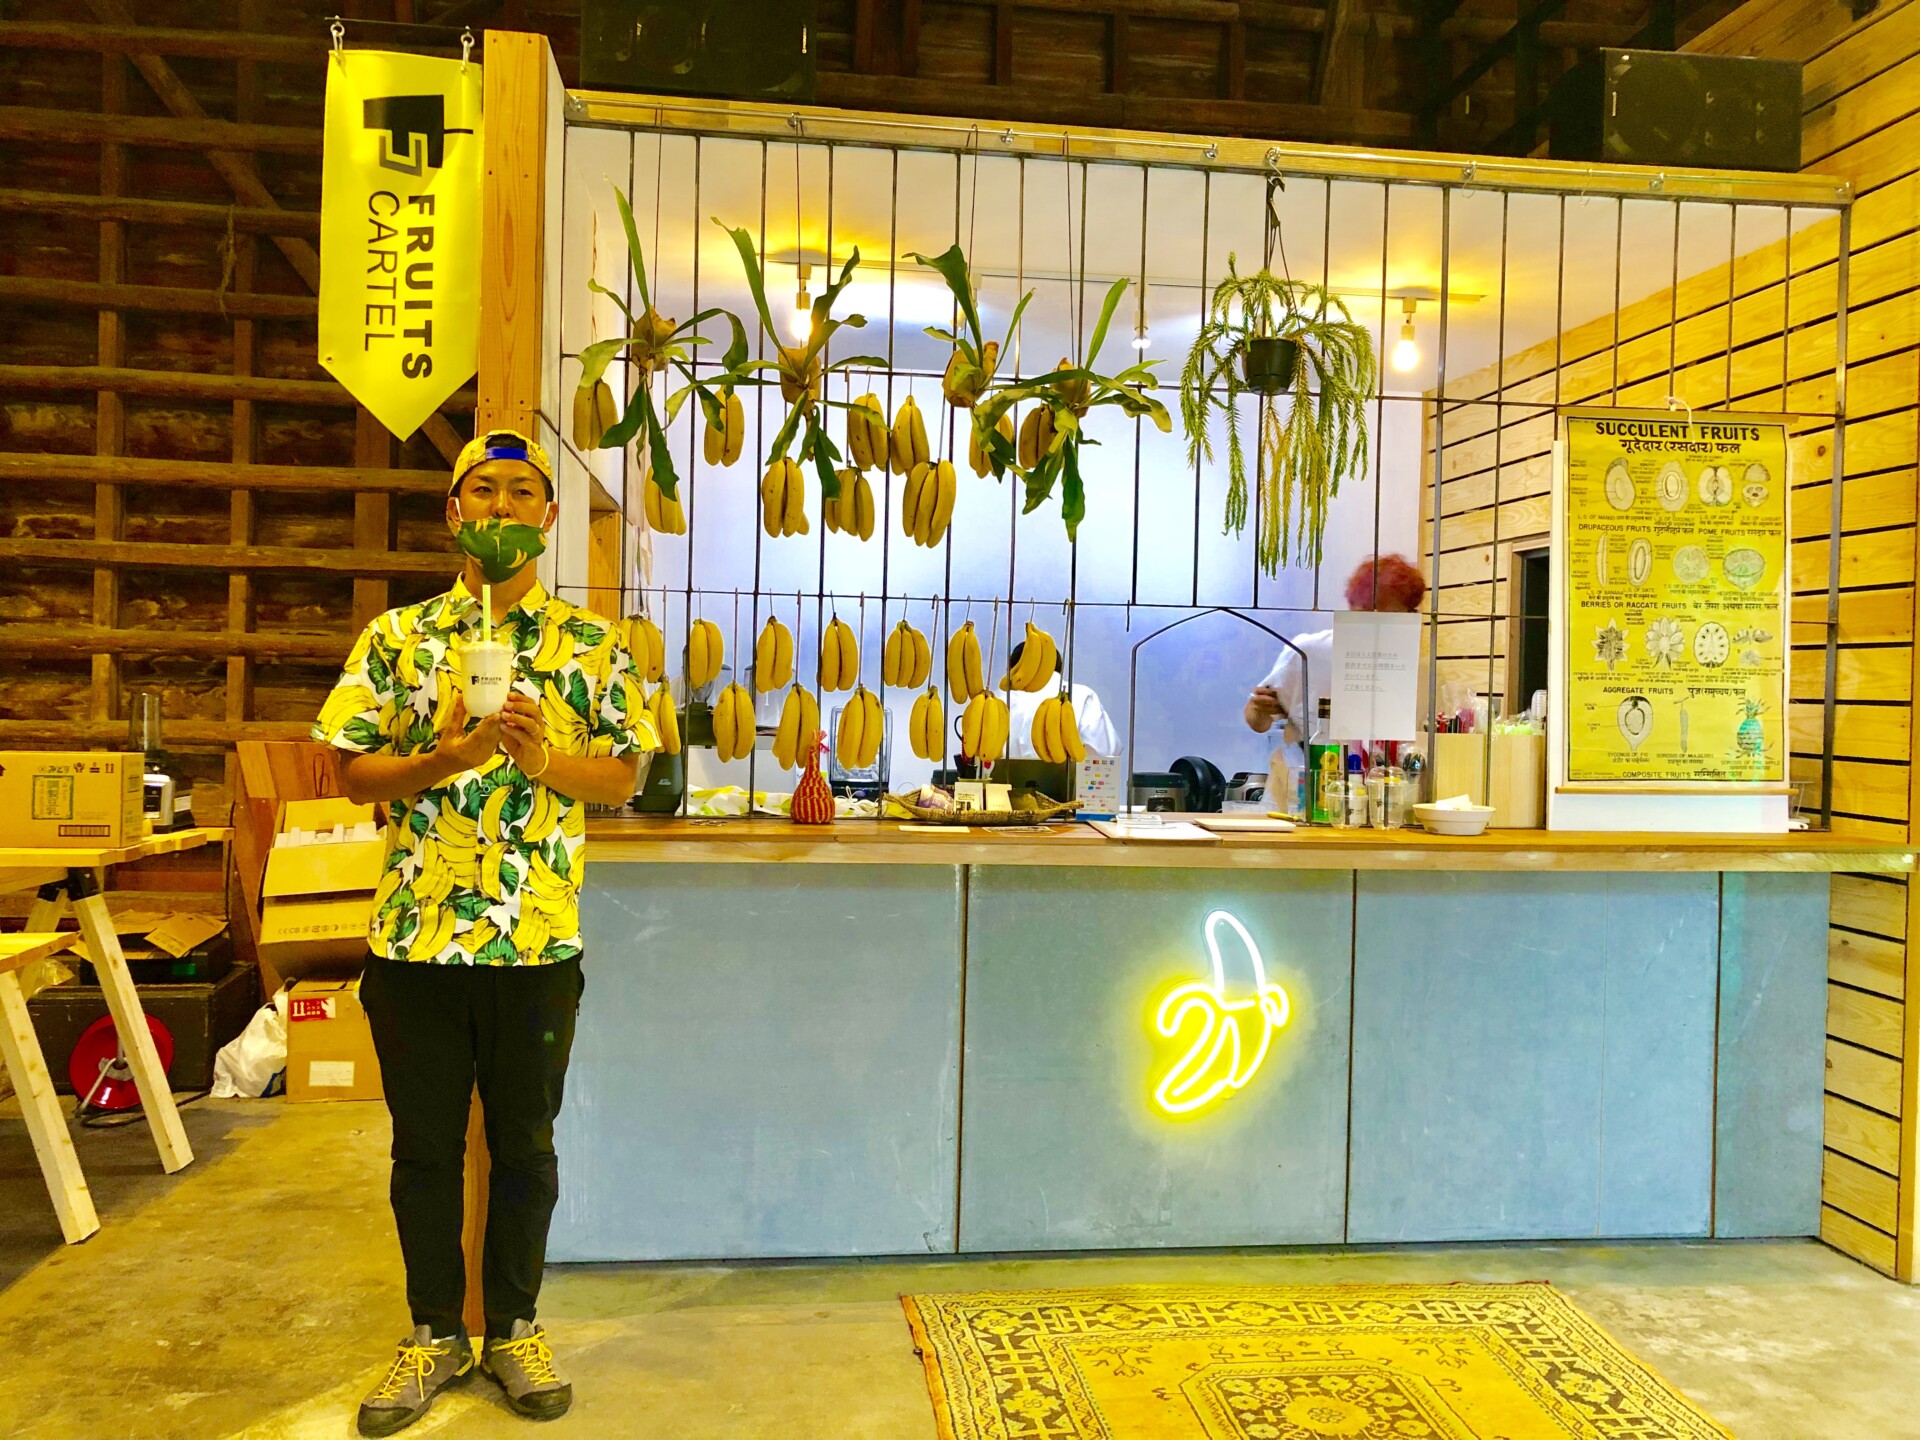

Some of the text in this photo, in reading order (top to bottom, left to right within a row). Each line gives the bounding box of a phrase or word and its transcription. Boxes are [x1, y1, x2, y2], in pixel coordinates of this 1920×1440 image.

[364, 190, 400, 352] CARTEL
[402, 194, 436, 379] FRUITS
[1595, 421, 1760, 441] SUCCULENT FRUITS
[1716, 442, 1741, 453] फल
[1626, 525, 1651, 533] FRUITS
[1613, 601, 1623, 609] OR
[1661, 602, 1687, 610] FRUITS
[1603, 686, 1644, 694] AGGREGATE
